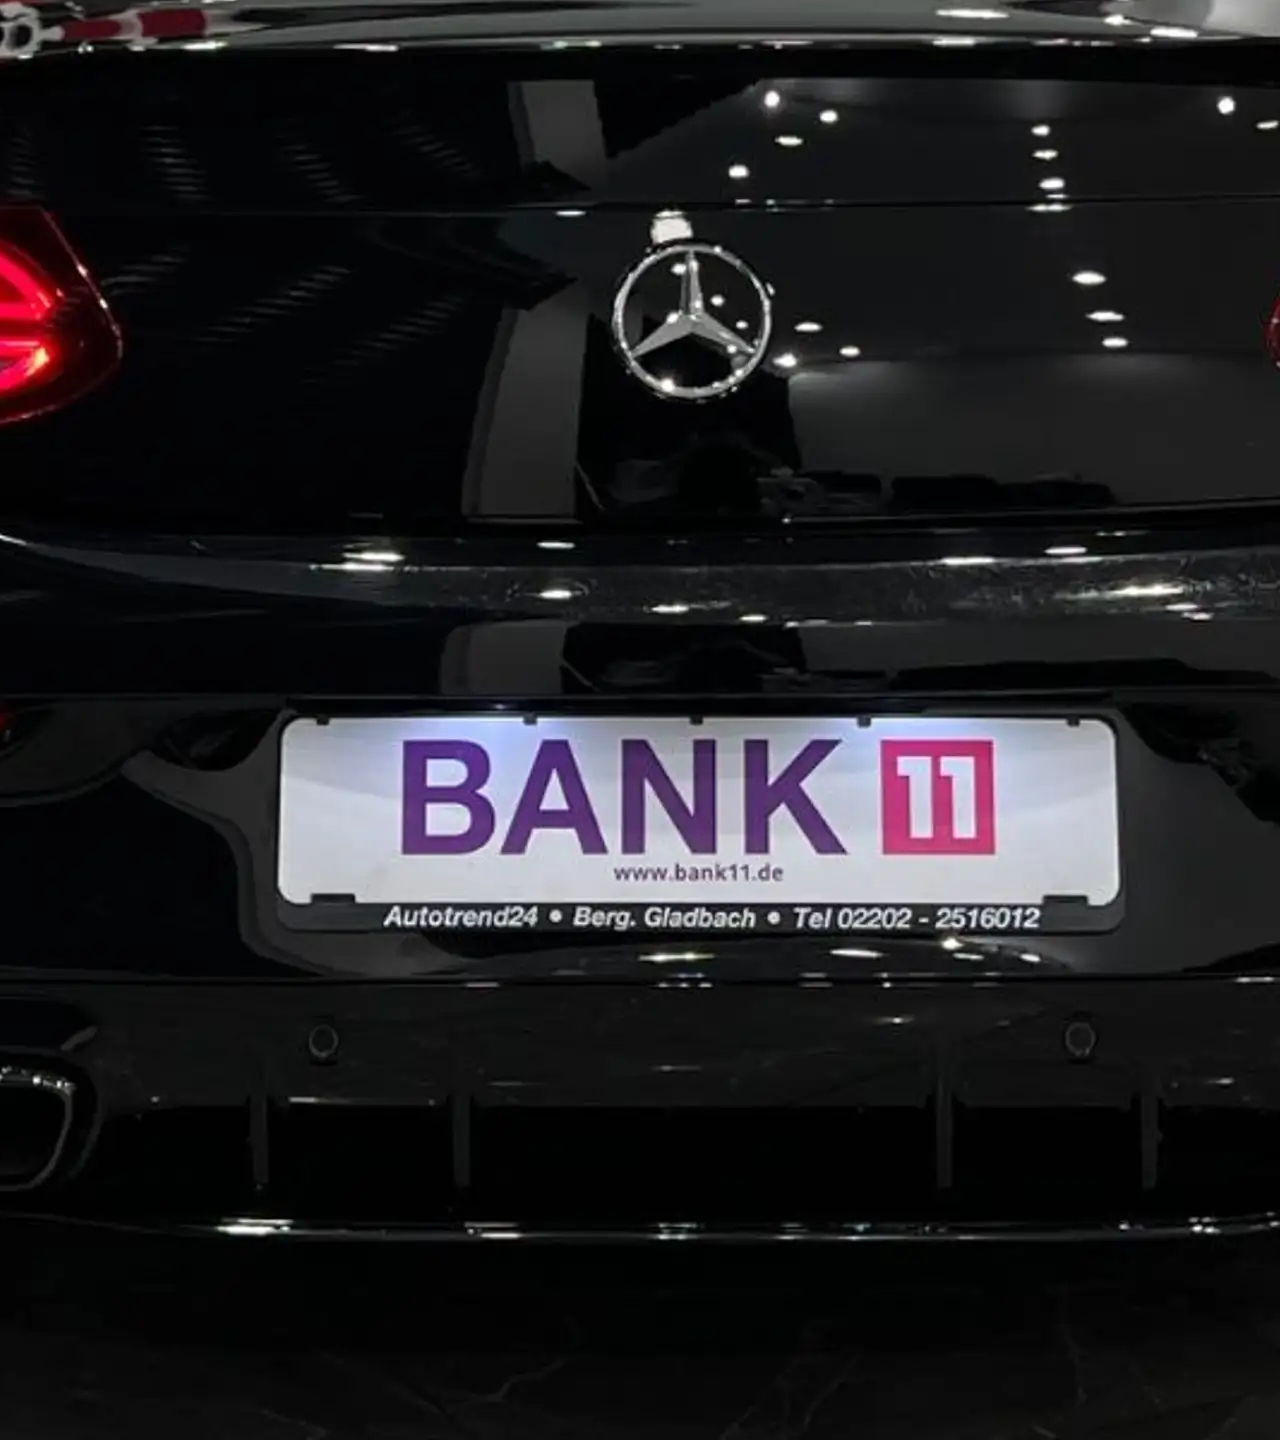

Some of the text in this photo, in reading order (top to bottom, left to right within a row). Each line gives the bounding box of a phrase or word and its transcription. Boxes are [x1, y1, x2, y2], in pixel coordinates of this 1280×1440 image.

[401, 739, 976, 855] BANK 11
[613, 863, 784, 882] www.bank11.de
[383, 905, 539, 927] Autotrend24
[573, 906, 636, 931] Berg.
[644, 906, 756, 929] Gladbach
[795, 908, 832, 929] Tel
[838, 908, 912, 929] 02202
[936, 907, 1041, 930] 2516012
